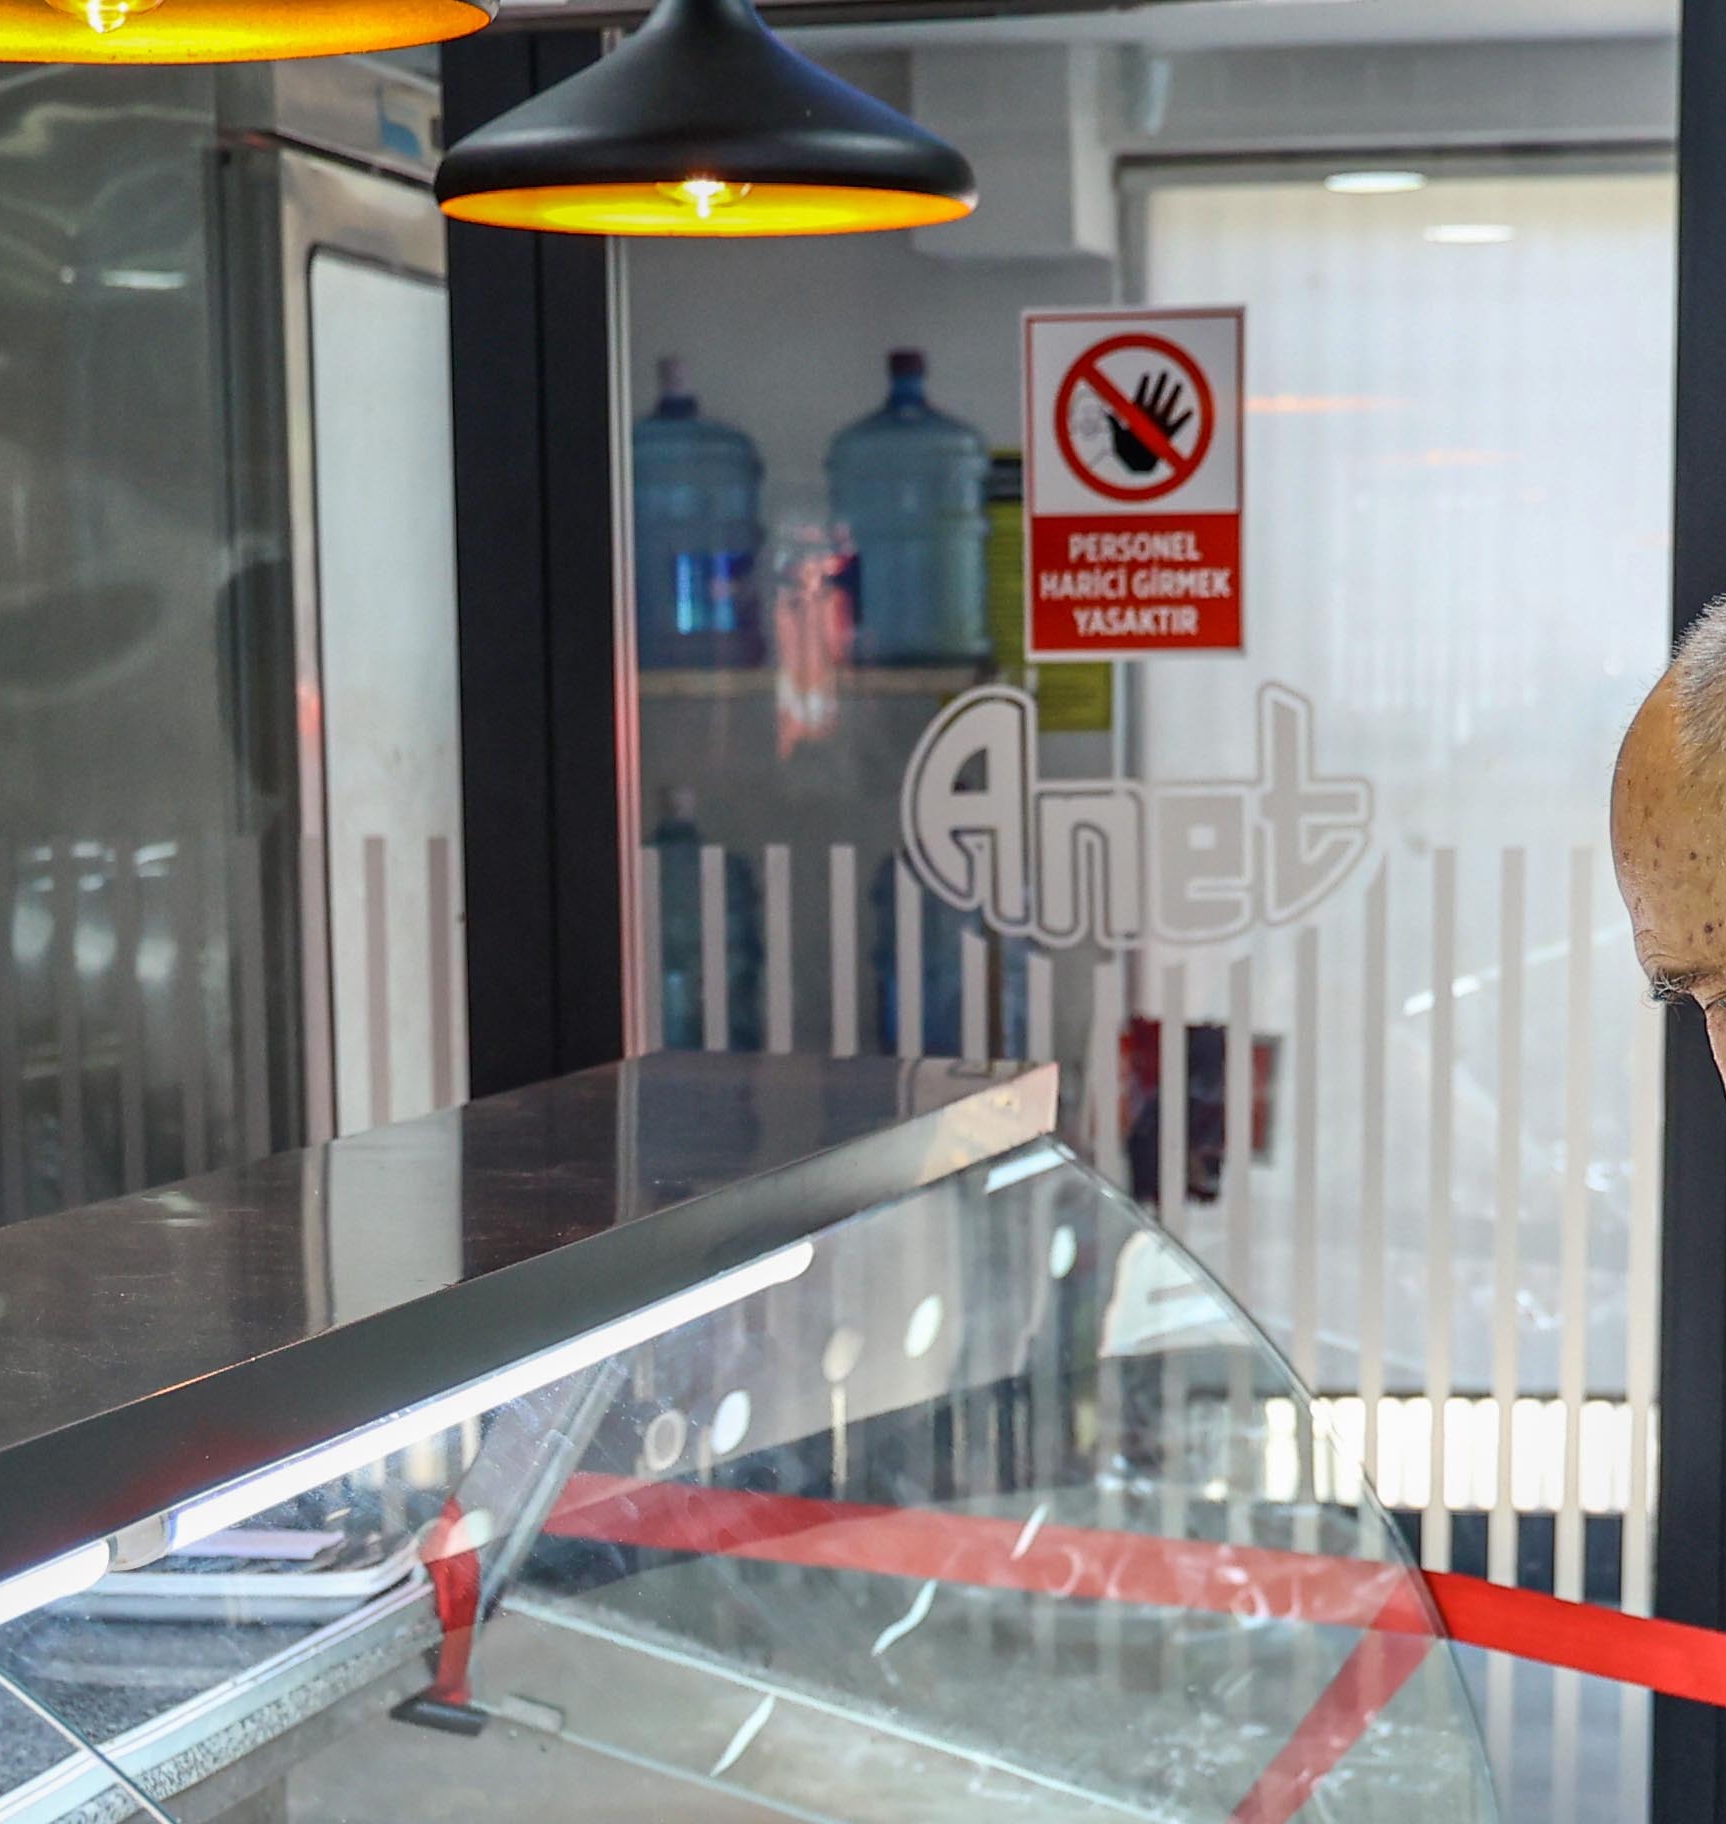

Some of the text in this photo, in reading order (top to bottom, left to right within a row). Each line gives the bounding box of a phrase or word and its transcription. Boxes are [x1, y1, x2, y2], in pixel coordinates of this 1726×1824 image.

[1068, 531, 1203, 563] PERSONEL
[1131, 563, 1232, 599] GİRMEK
[1072, 605, 1199, 637] YASAKTIR
[901, 681, 1373, 948] Anet
